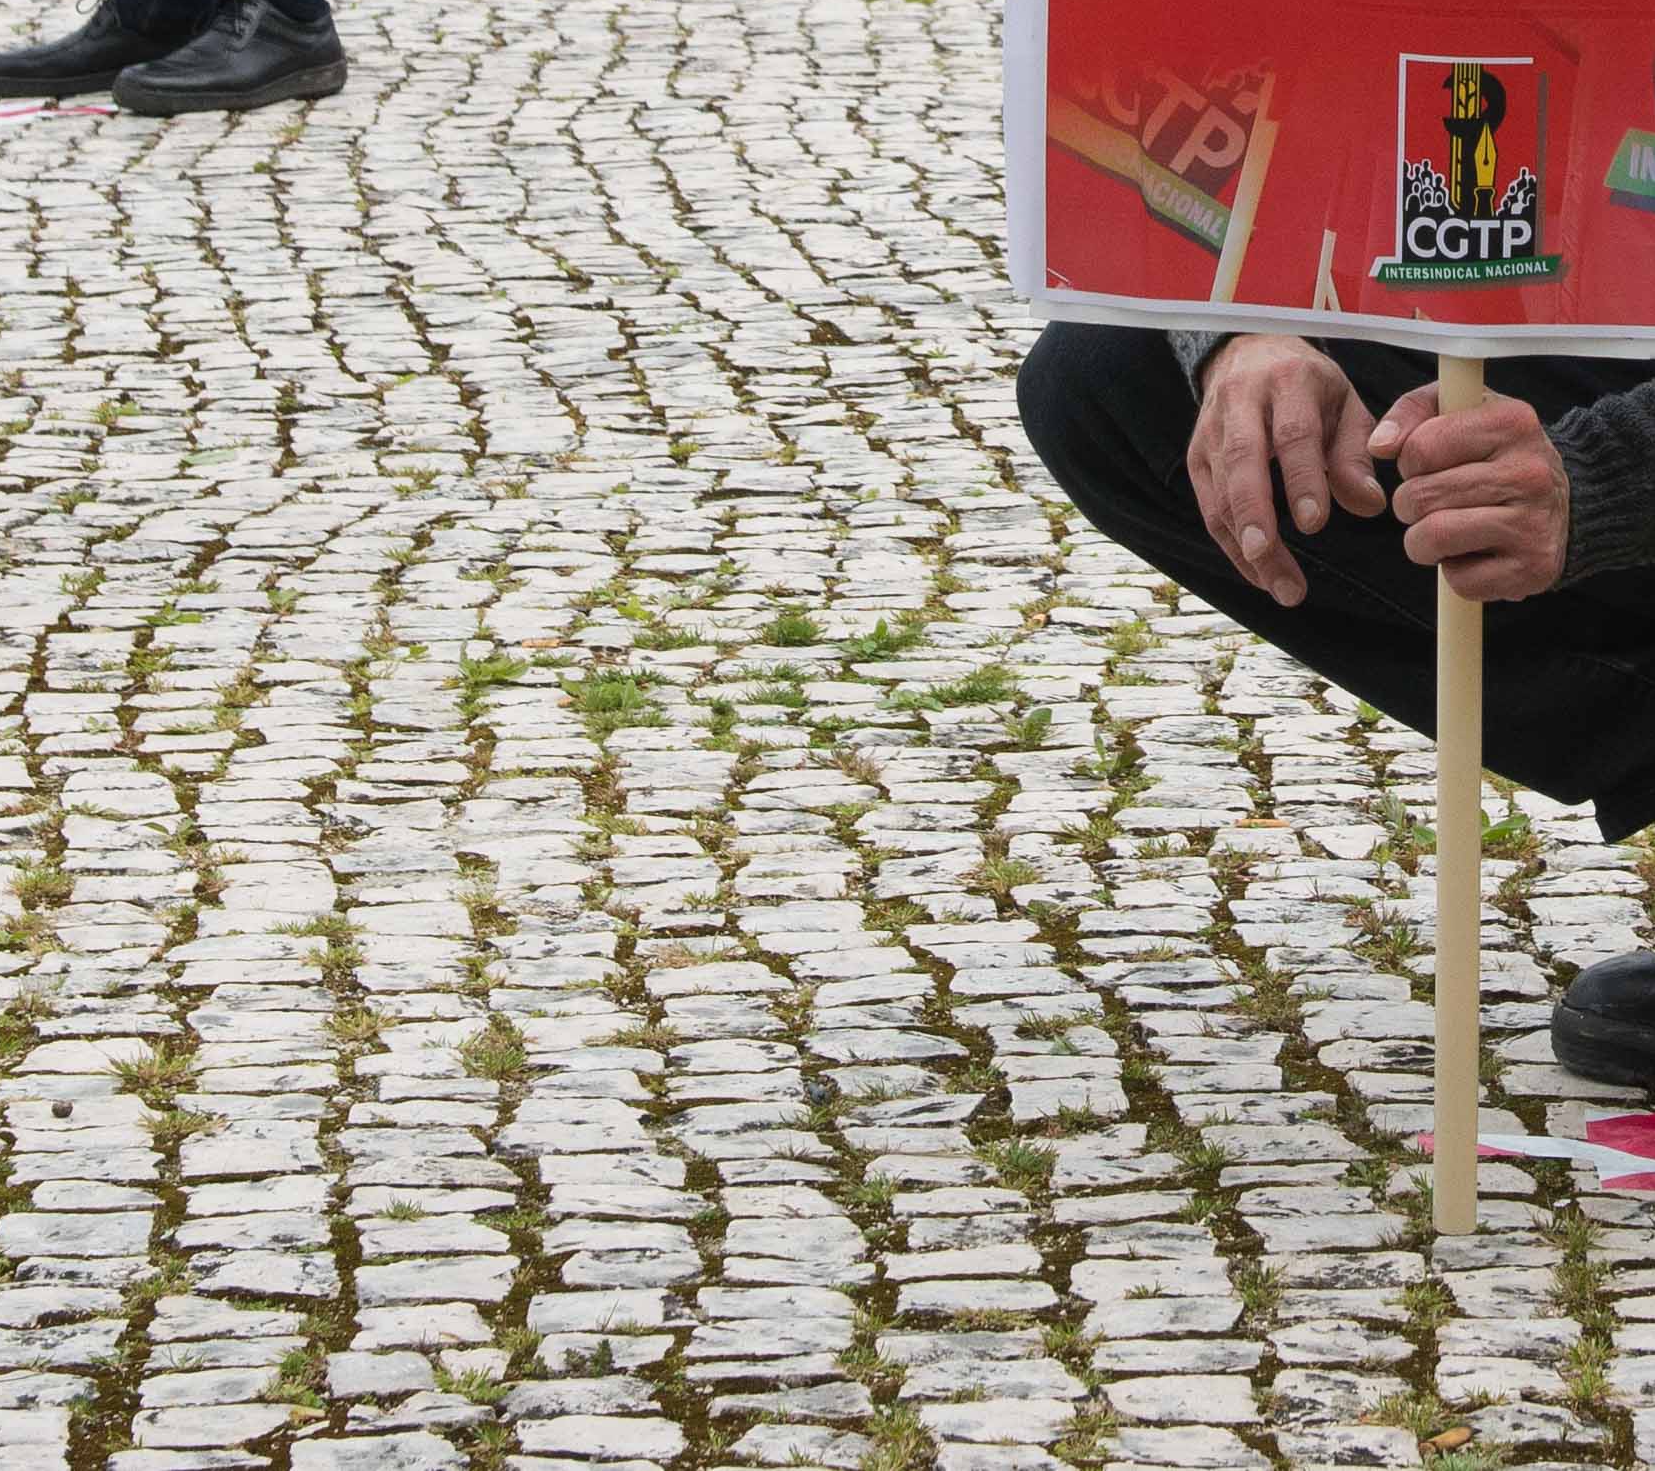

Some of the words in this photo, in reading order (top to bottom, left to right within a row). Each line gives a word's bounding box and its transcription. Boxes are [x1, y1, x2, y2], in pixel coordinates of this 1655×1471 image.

[1407, 217, 1533, 259] CGTP
[1384, 265, 1481, 280] INTERSINDICAL
[1485, 259, 1550, 278] NACIONAL
